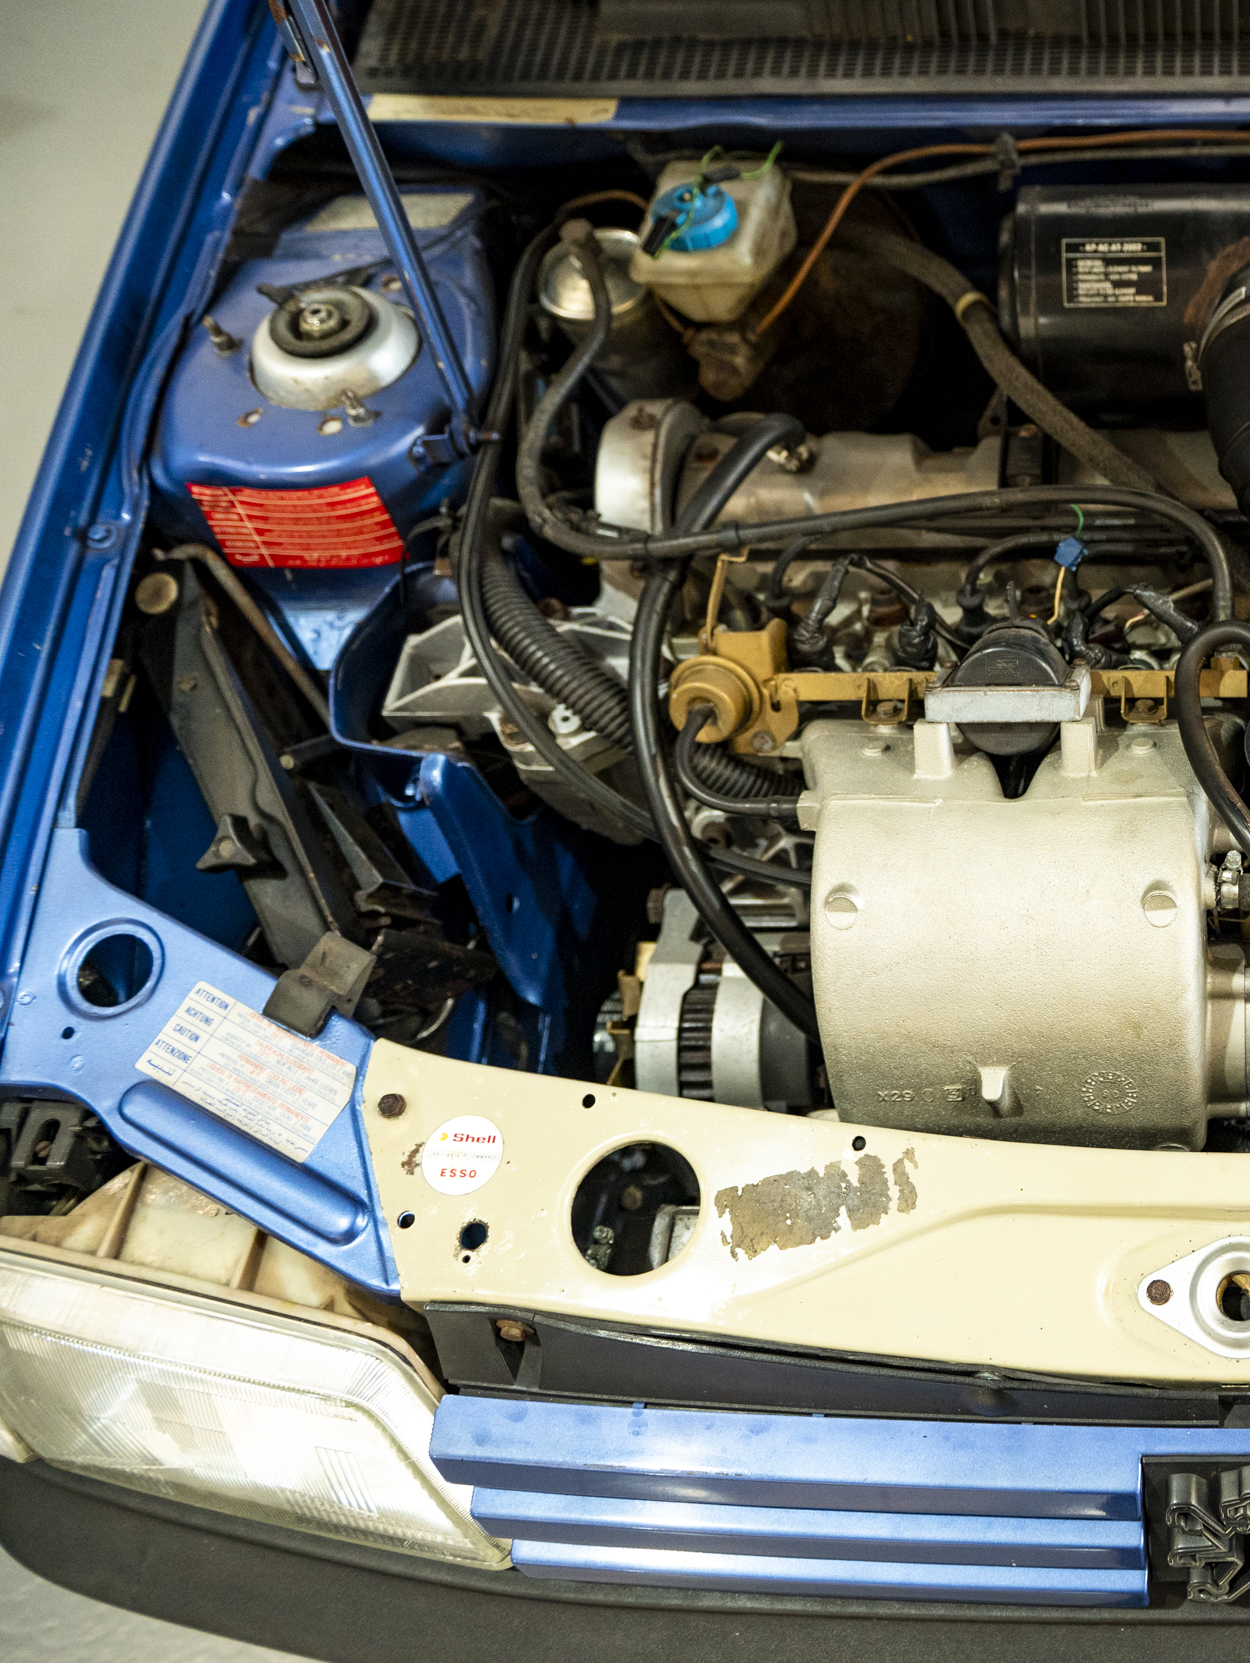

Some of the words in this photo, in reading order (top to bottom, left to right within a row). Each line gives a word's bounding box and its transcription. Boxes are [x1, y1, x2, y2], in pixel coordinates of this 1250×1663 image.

[194, 986, 230, 1011] ATTENTION
[183, 1005, 214, 1027] ACHTUNG
[172, 1022, 200, 1043] CAUTION
[153, 1038, 192, 1064] ATTENZIONE
[317, 1048, 348, 1069] PERMANENT
[236, 1053, 267, 1073] PERMANENT
[279, 1085, 297, 1098] EVERY
[300, 1096, 318, 1109] YEARS
[318, 1081, 338, 1096] LEEREN
[232, 1076, 278, 1105] RAFFREDDAMENTO
[277, 1101, 310, 1123] PERMANENTE
[452, 1132, 497, 1144] Shell
[440, 1168, 477, 1179] ESSO
